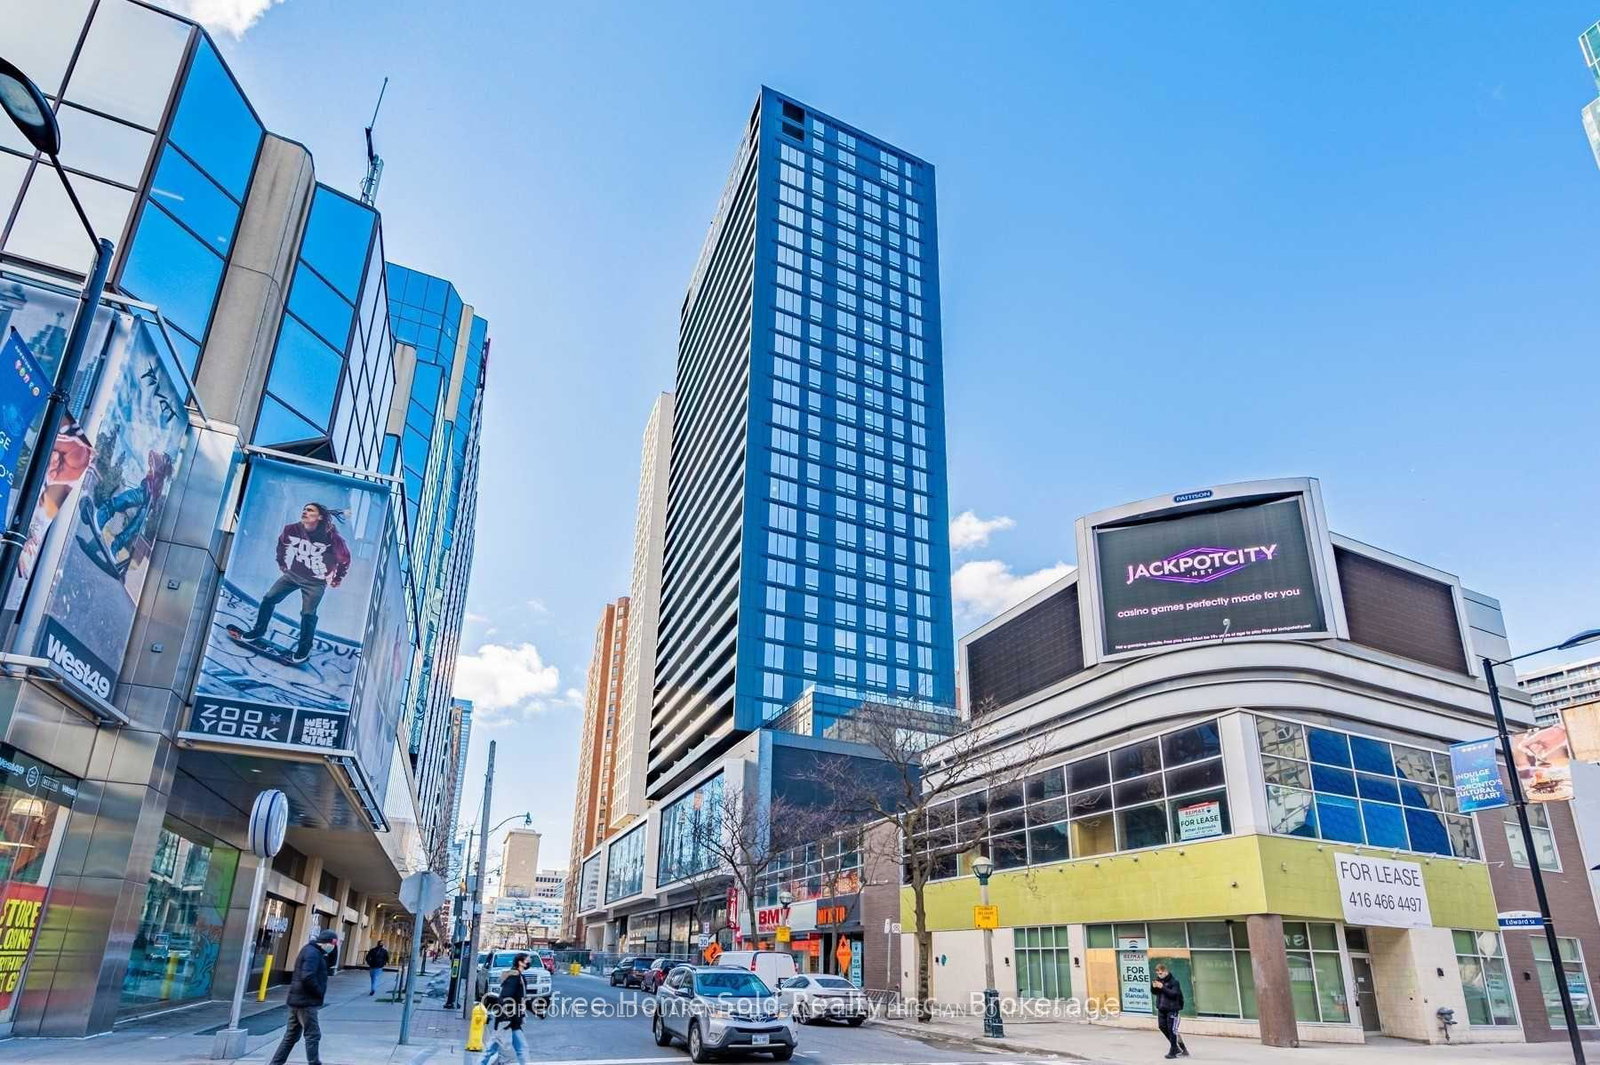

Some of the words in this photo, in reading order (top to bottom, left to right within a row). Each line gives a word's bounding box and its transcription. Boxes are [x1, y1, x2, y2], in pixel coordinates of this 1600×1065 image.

[1176, 491, 1211, 502] PATTISON
[1126, 544, 1277, 585] JACKPOTCITY
[1117, 607, 1149, 619] casino
[1151, 603, 1184, 615] games
[1186, 597, 1229, 611] perfectly
[1231, 593, 1262, 604] made
[1264, 590, 1278, 600] for
[1280, 588, 1301, 600] you
[47, 633, 110, 698] West49
[200, 704, 263, 724] ZOO
[199, 718, 279, 741] YORK
[304, 718, 338, 730] WEST
[303, 727, 338, 738] FORTY
[301, 736, 333, 747] NINE
[1456, 768, 1491, 780] INDULGE
[1470, 776, 1479, 784] IN
[1456, 778, 1503, 792] TORONTO'S
[1456, 786, 1497, 798] CULTURAL
[1472, 791, 1501, 801] HEART
[1180, 819, 1195, 827] FOR
[1196, 814, 1219, 825] LEASE
[1340, 861, 1372, 881] FOR
[1375, 865, 1420, 887] LEASE
[1349, 891, 1371, 908] 416
[1374, 894, 1395, 910] 466
[1397, 896, 1422, 912] 4497
[0, 898, 42, 928] STORE
[1126, 966, 1145, 974] FOR
[1123, 974, 1149, 983] LEASE
